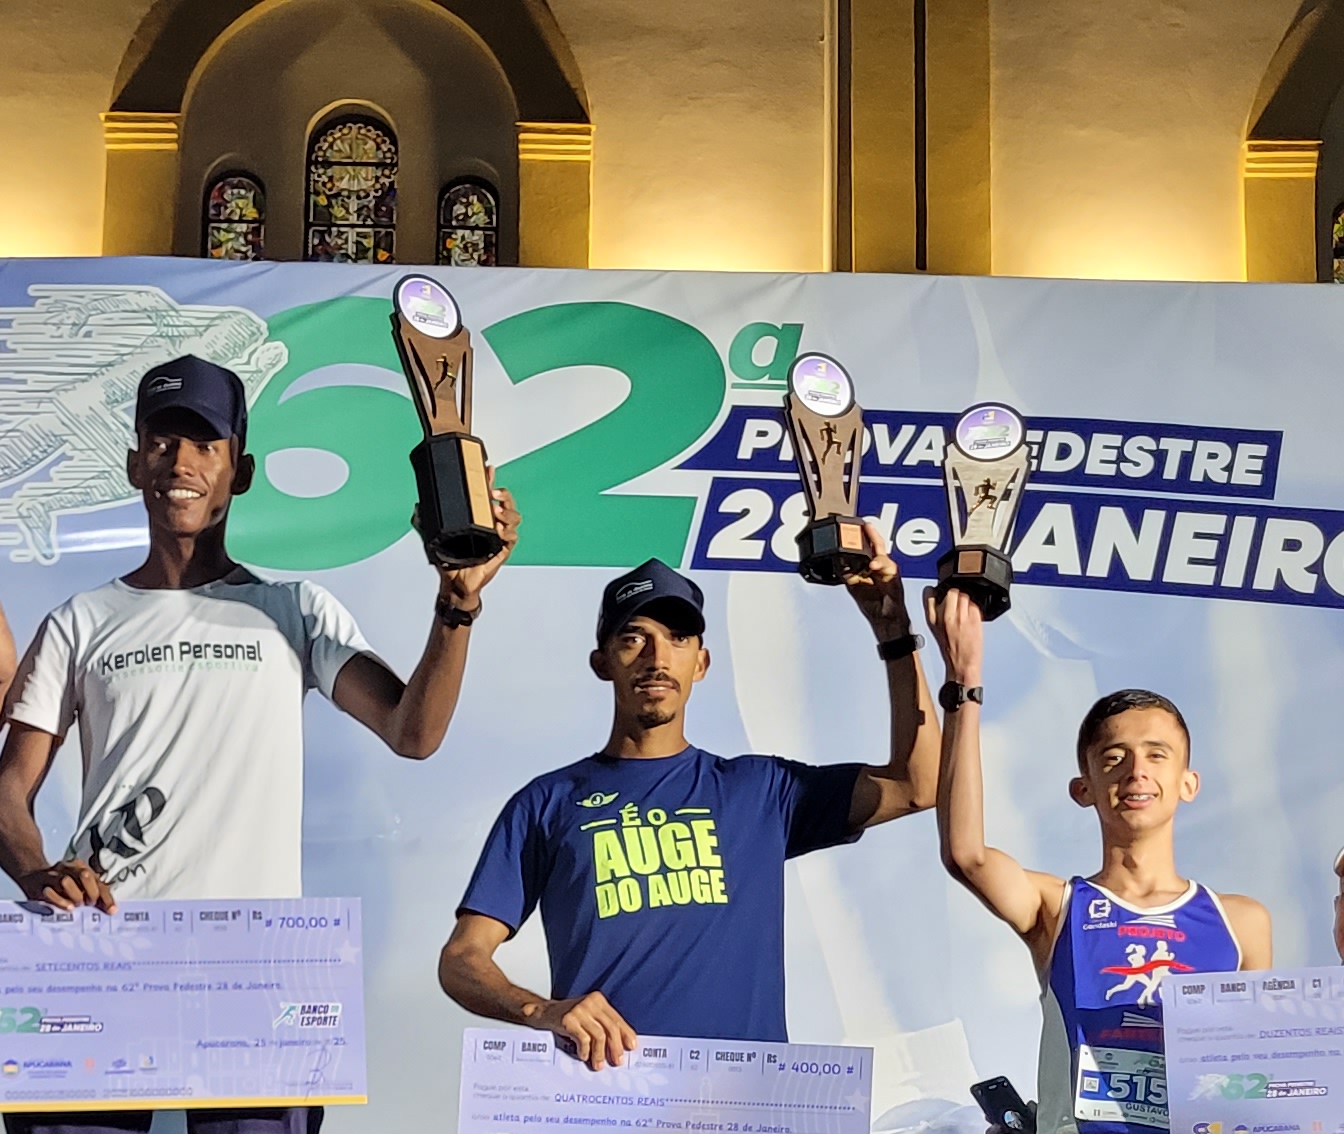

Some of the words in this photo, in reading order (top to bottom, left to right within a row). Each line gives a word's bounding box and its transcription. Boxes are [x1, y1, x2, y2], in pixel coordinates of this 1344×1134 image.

[1025, 429, 1269, 486] EDESTRE
[706, 489, 811, 562] 28
[101, 644, 174, 675] Kerolen
[179, 640, 262, 662] Personal
[620, 802, 642, 826] É
[647, 807, 668, 826] O
[593, 819, 723, 884] AUGE
[594, 876, 643, 919] DO
[648, 868, 729, 908] AUGE
[124, 912, 150, 922] CONTA
[172, 911, 183, 921] C2
[199, 911, 229, 921] CHEQUE
[278, 917, 328, 929] 700,00
[1118, 925, 1187, 942] PROJETO
[35, 962, 100, 972] SETECENTOS
[5, 985, 24, 996] pelo
[27, 986, 44, 994] seu
[46, 984, 102, 995] desempenho
[142, 983, 170, 991] Prova
[173, 982, 212, 991] Pedestre
[216, 982, 228, 990] 28
[232, 982, 243, 990] de
[1182, 984, 1206, 995] COMP
[1220, 982, 1247, 993] BANCO
[1262, 977, 1296, 991] AGÊNCIA
[1312, 978, 1322, 989] C1
[300, 1004, 330, 1015] BANCO
[61, 1022, 103, 1032] JANEIRO
[300, 1016, 339, 1026] ESPORTE
[1258, 1027, 1312, 1039] DUZENTOS
[23, 1059, 73, 1068] APUCARANA
[483, 1040, 506, 1051] COMP
[521, 1041, 548, 1053] BANCO
[642, 1047, 668, 1058] CONTA
[689, 1050, 701, 1060] C2
[715, 1051, 745, 1063] CHEQUE
[791, 1062, 841, 1075] 400,00
[1200, 1054, 1228, 1063] atleta
[1231, 1053, 1250, 1063] pelo
[1271, 1050, 1327, 1061] desempenho
[1107, 1073, 1168, 1105] 515
[1288, 1086, 1327, 1097] JANEIRO
[554, 1092, 634, 1106] QUATROCENTOS
[1125, 1101, 1169, 1118] GUSTAVO
[492, 1113, 520, 1122] atleta
[523, 1114, 542, 1124] pelo
[545, 1116, 560, 1124] seu
[563, 1115, 618, 1127] desempenho
[620, 1119, 632, 1127] na
[656, 1119, 682, 1129] Prova
[685, 1120, 724, 1131] Pedestre
[727, 1122, 739, 1131] 28
[742, 1123, 753, 1132] de
[756, 1124, 792, 1134] Janeiro.
[1253, 1123, 1301, 1133] APUCARANA
